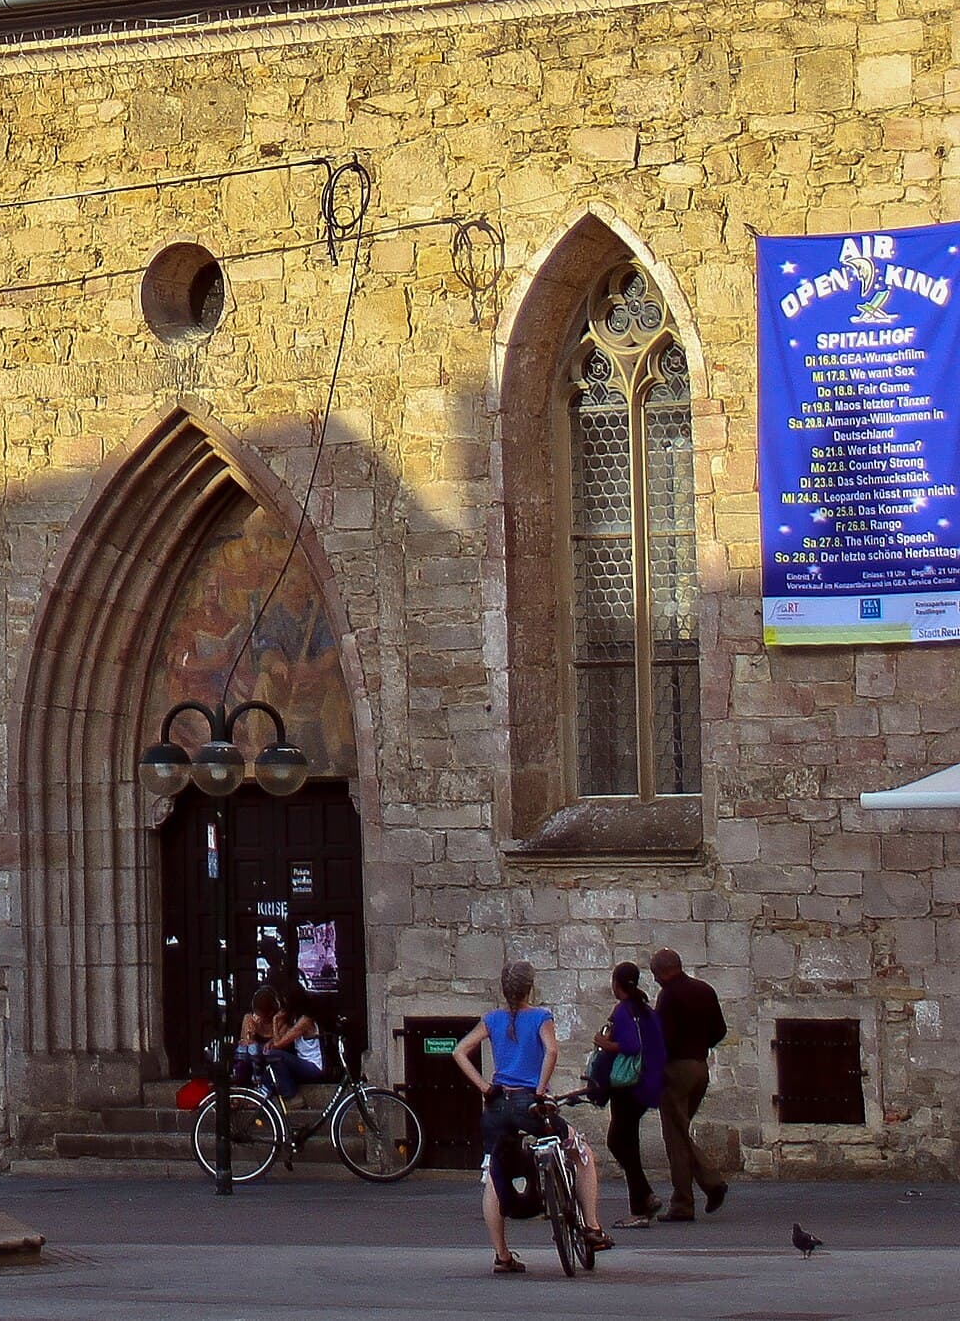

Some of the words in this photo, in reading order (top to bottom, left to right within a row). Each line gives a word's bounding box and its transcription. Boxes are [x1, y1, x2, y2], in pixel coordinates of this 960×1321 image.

[839, 235, 894, 261] AIR
[780, 267, 850, 318] OPEN
[884, 264, 949, 306] KINO
[816, 327, 915, 349] SPITALHOF
[805, 355, 816, 367] Di
[812, 372, 824, 382] Mi
[826, 371, 848, 381] 17.8.
[850, 369, 865, 380] We
[868, 367, 892, 379] want
[894, 366, 914, 376] Sex
[817, 386, 832, 397] Do
[833, 385, 855, 396] 18.8.
[858, 383, 878, 394] Fair
[879, 382, 910, 393] Game
[802, 403, 812, 413] Fr
[813, 402, 832, 412] 19.8.
[834, 400, 860, 411] Maos
[863, 397, 894, 409] letzter
[897, 395, 930, 407] Tänzer
[788, 418, 803, 429] Sa
[805, 417, 824, 427] 20.8.
[933, 409, 944, 420] in
[833, 428, 894, 442] Deutschland
[812, 448, 824, 458] So
[826, 447, 846, 457] 21.8.
[848, 445, 866, 455] Wer
[869, 443, 882, 454] ist
[883, 441, 922, 453] Hanna?
[811, 463, 826, 473] Mo
[827, 462, 846, 472] 22.8.
[848, 460, 887, 471] Country
[889, 457, 924, 470] Strong
[800, 477, 811, 488] Di
[814, 476, 836, 487] 23.8.
[837, 475, 854, 486] Das
[857, 471, 929, 485] Schmuckstück
[782, 493, 795, 504] Mi
[797, 493, 821, 503] 24.8.
[824, 491, 871, 504] Leoparden
[873, 488, 900, 500] küsst
[902, 488, 925, 498] man
[928, 484, 955, 496] nicht
[836, 507, 856, 516] 25.8.
[858, 505, 876, 515] Das
[878, 504, 918, 514] Konzert
[836, 522, 846, 532] Fr
[848, 521, 868, 531] 26.8.
[870, 520, 902, 532] Rango
[803, 538, 817, 548] Sa
[819, 537, 843, 547] 27.8.
[844, 536, 862, 546] The
[896, 531, 935, 545] Speech
[775, 553, 789, 563] So
[792, 551, 818, 562] 28.8.
[820, 550, 839, 562] Der
[841, 549, 866, 561] letzte
[868, 547, 902, 560] schöne
[905, 545, 957, 559] Herbsttag
